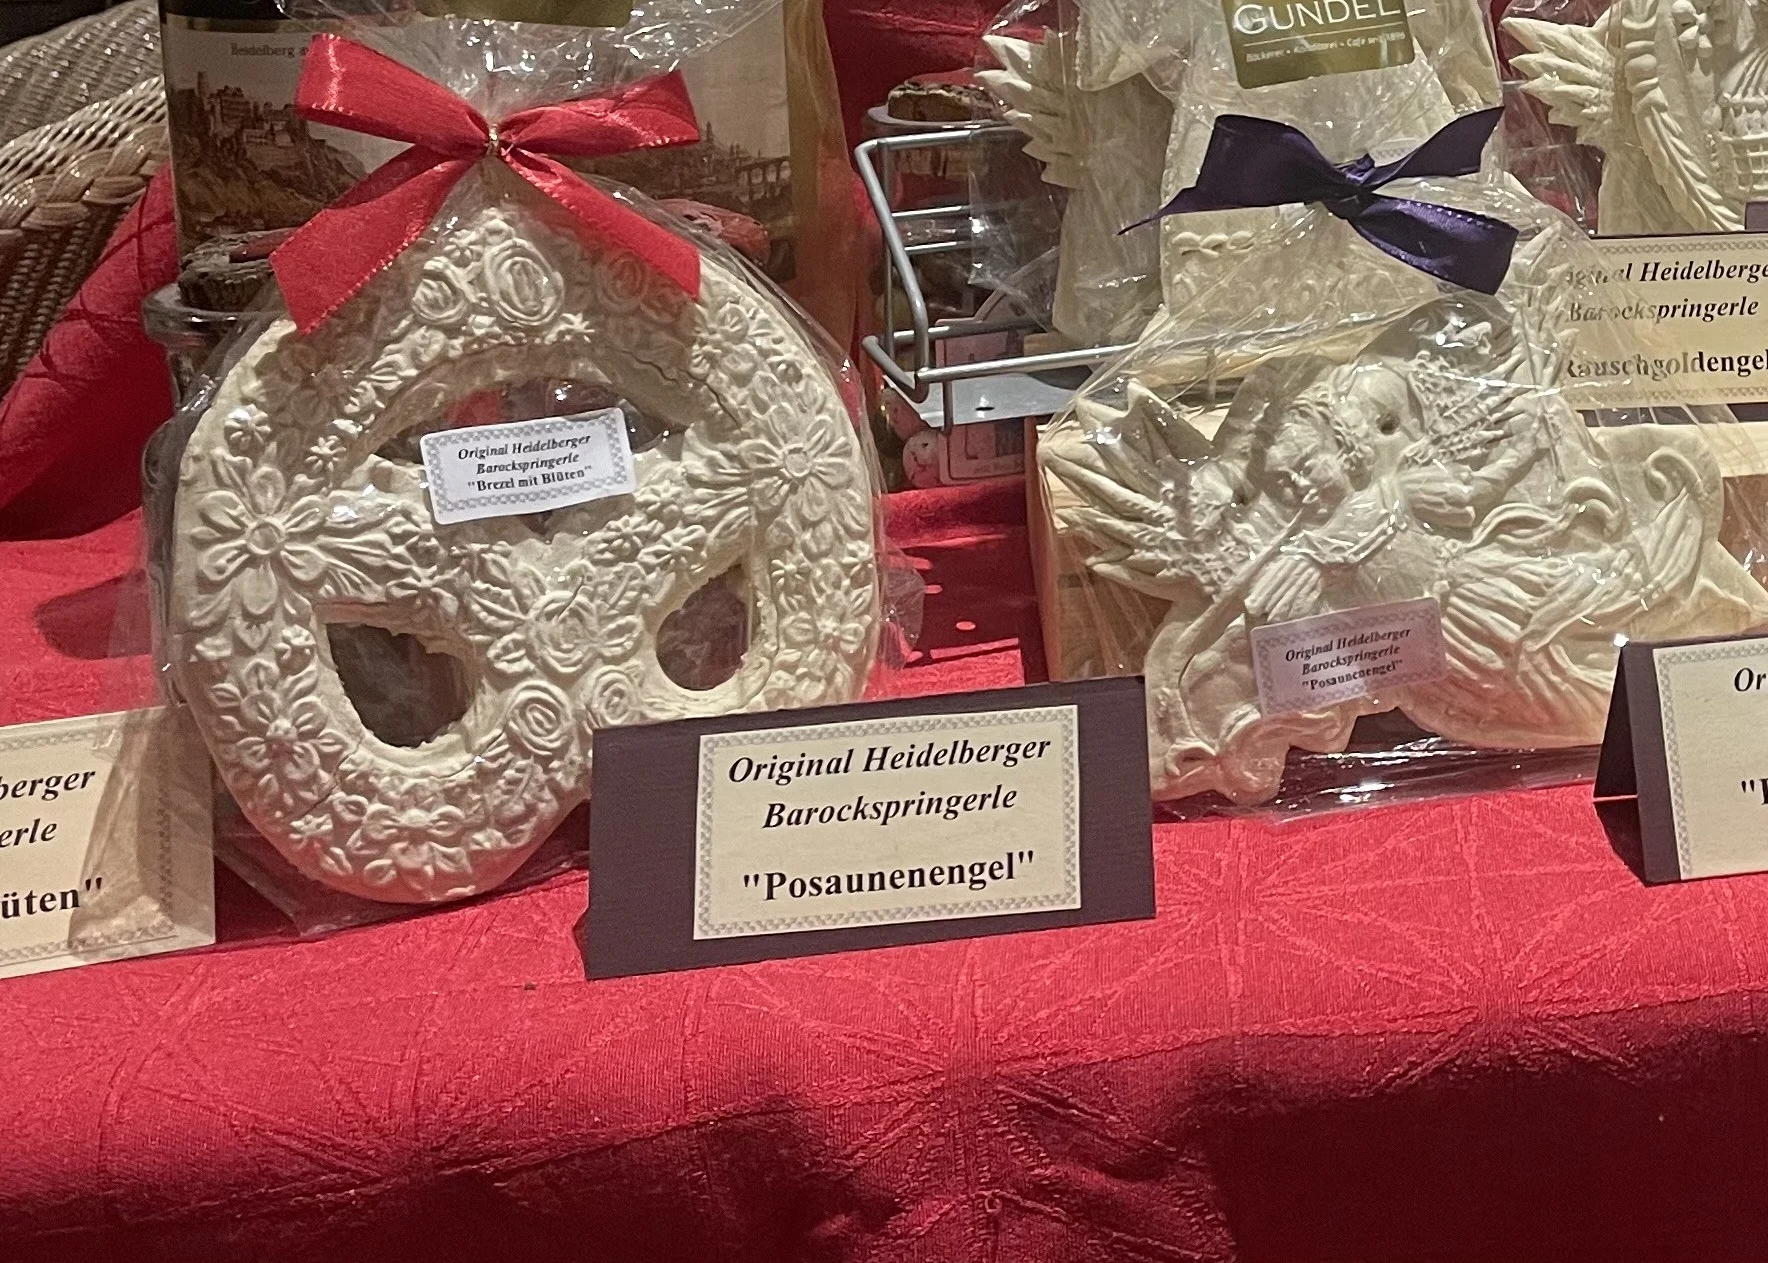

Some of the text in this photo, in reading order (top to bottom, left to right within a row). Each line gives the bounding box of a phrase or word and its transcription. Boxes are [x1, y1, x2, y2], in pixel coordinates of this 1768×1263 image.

[458, 434, 592, 460] Original Heidelberger
[476, 452, 580, 475] Barockspringerle
[467, 465, 593, 493] "Brezel mit Blüten"
[1285, 628, 1411, 662] Original Heidelberger
[1301, 644, 1401, 676] Barockspringerle
[1302, 658, 1403, 691] "Posaunenengel"
[727, 738, 1052, 786] Original Heidelberger
[761, 784, 1018, 829] Barockspringerle
[742, 849, 1035, 902] "Posaunenengel"
[1, 877, 103, 919] üten"
